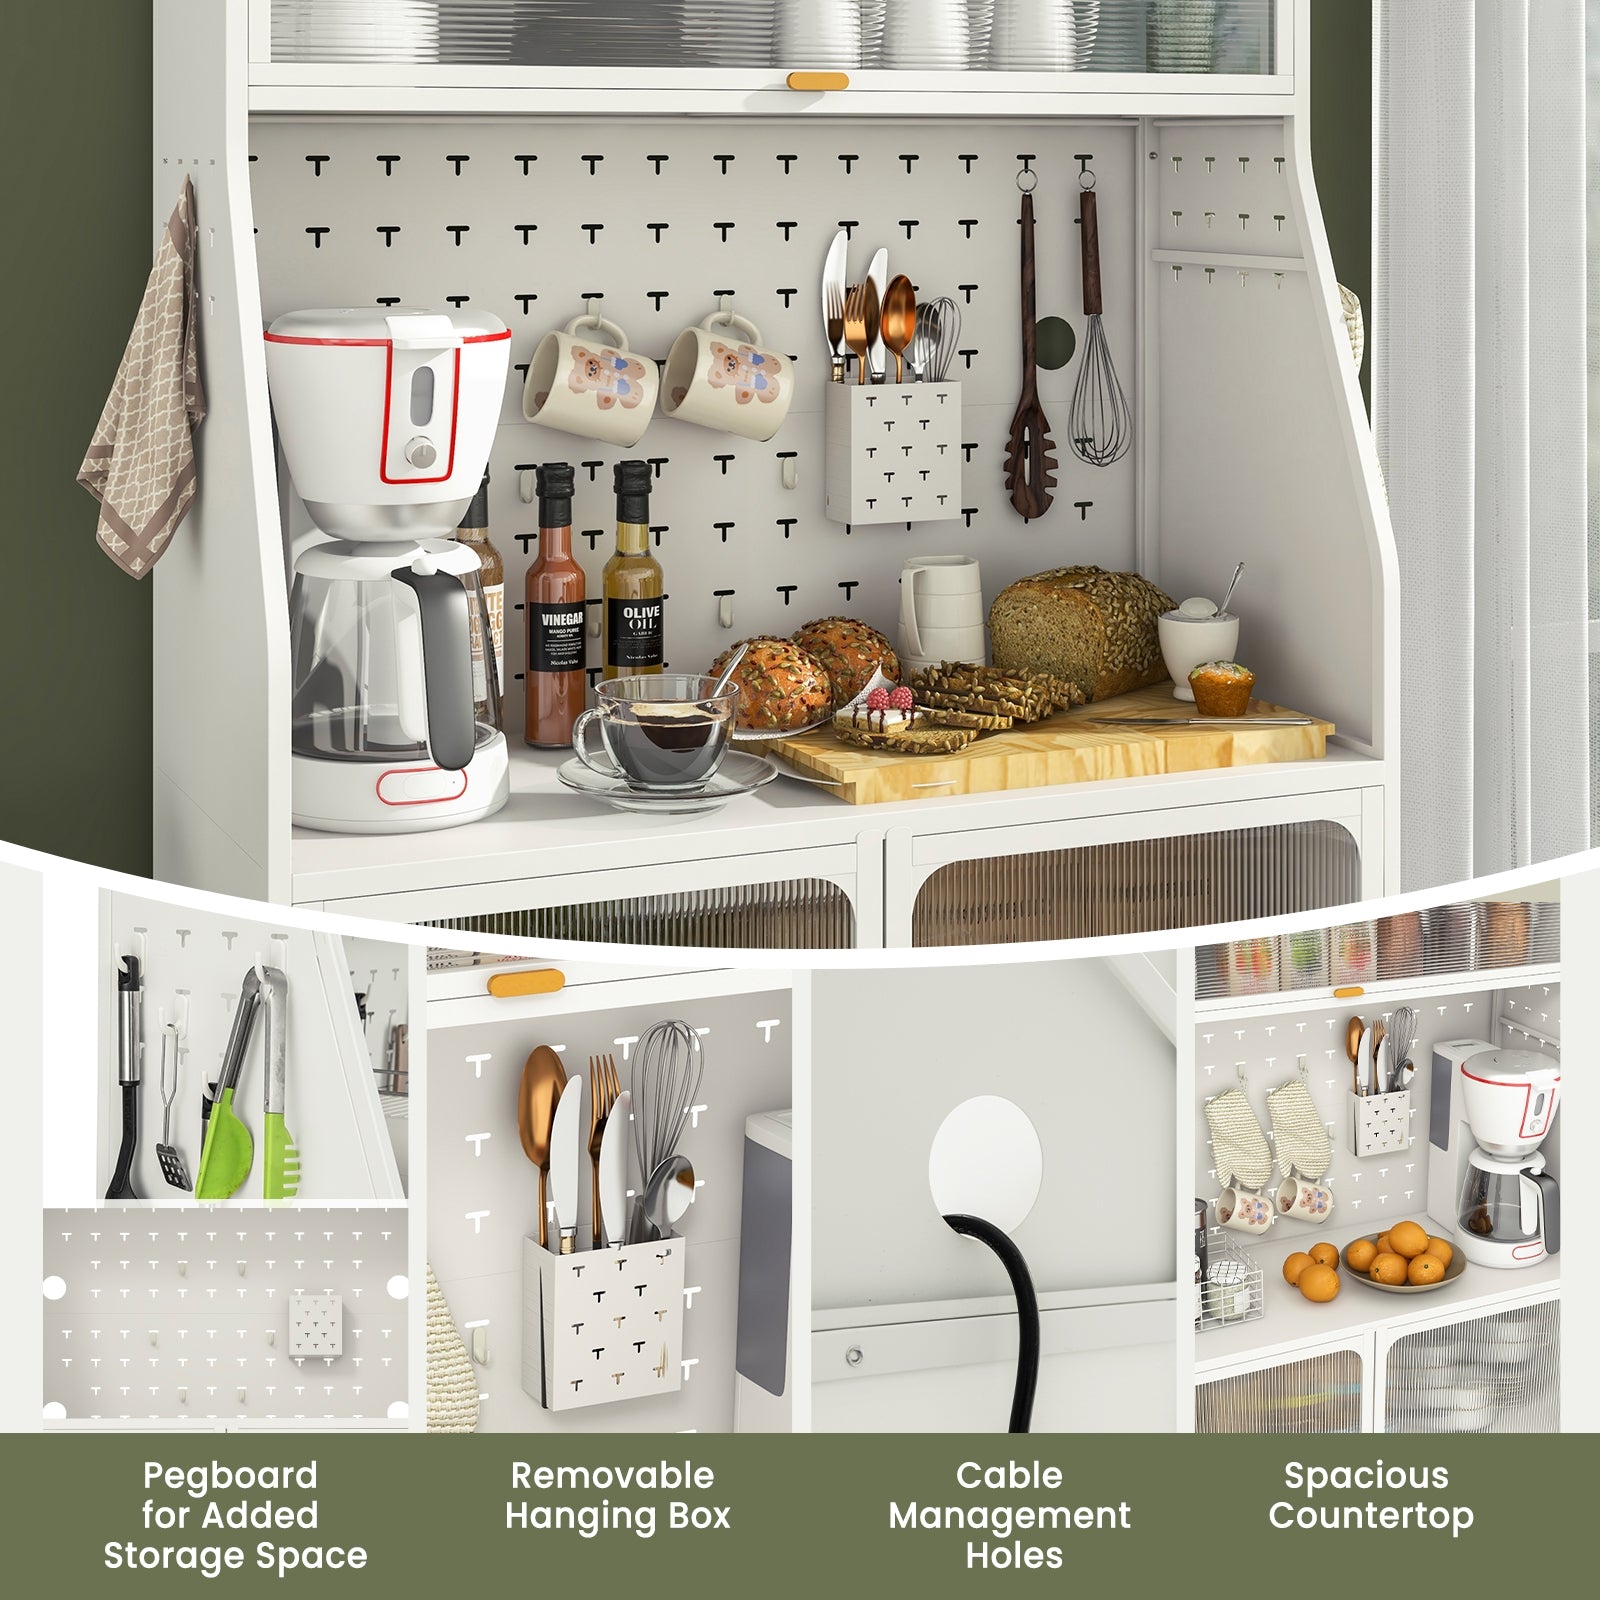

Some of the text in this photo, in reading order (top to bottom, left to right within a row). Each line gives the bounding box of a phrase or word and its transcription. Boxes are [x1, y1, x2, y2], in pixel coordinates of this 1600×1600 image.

[541, 611, 584, 626] VINEGAR
[623, 605, 660, 619] OLIVE
[629, 618, 657, 629] OIL
